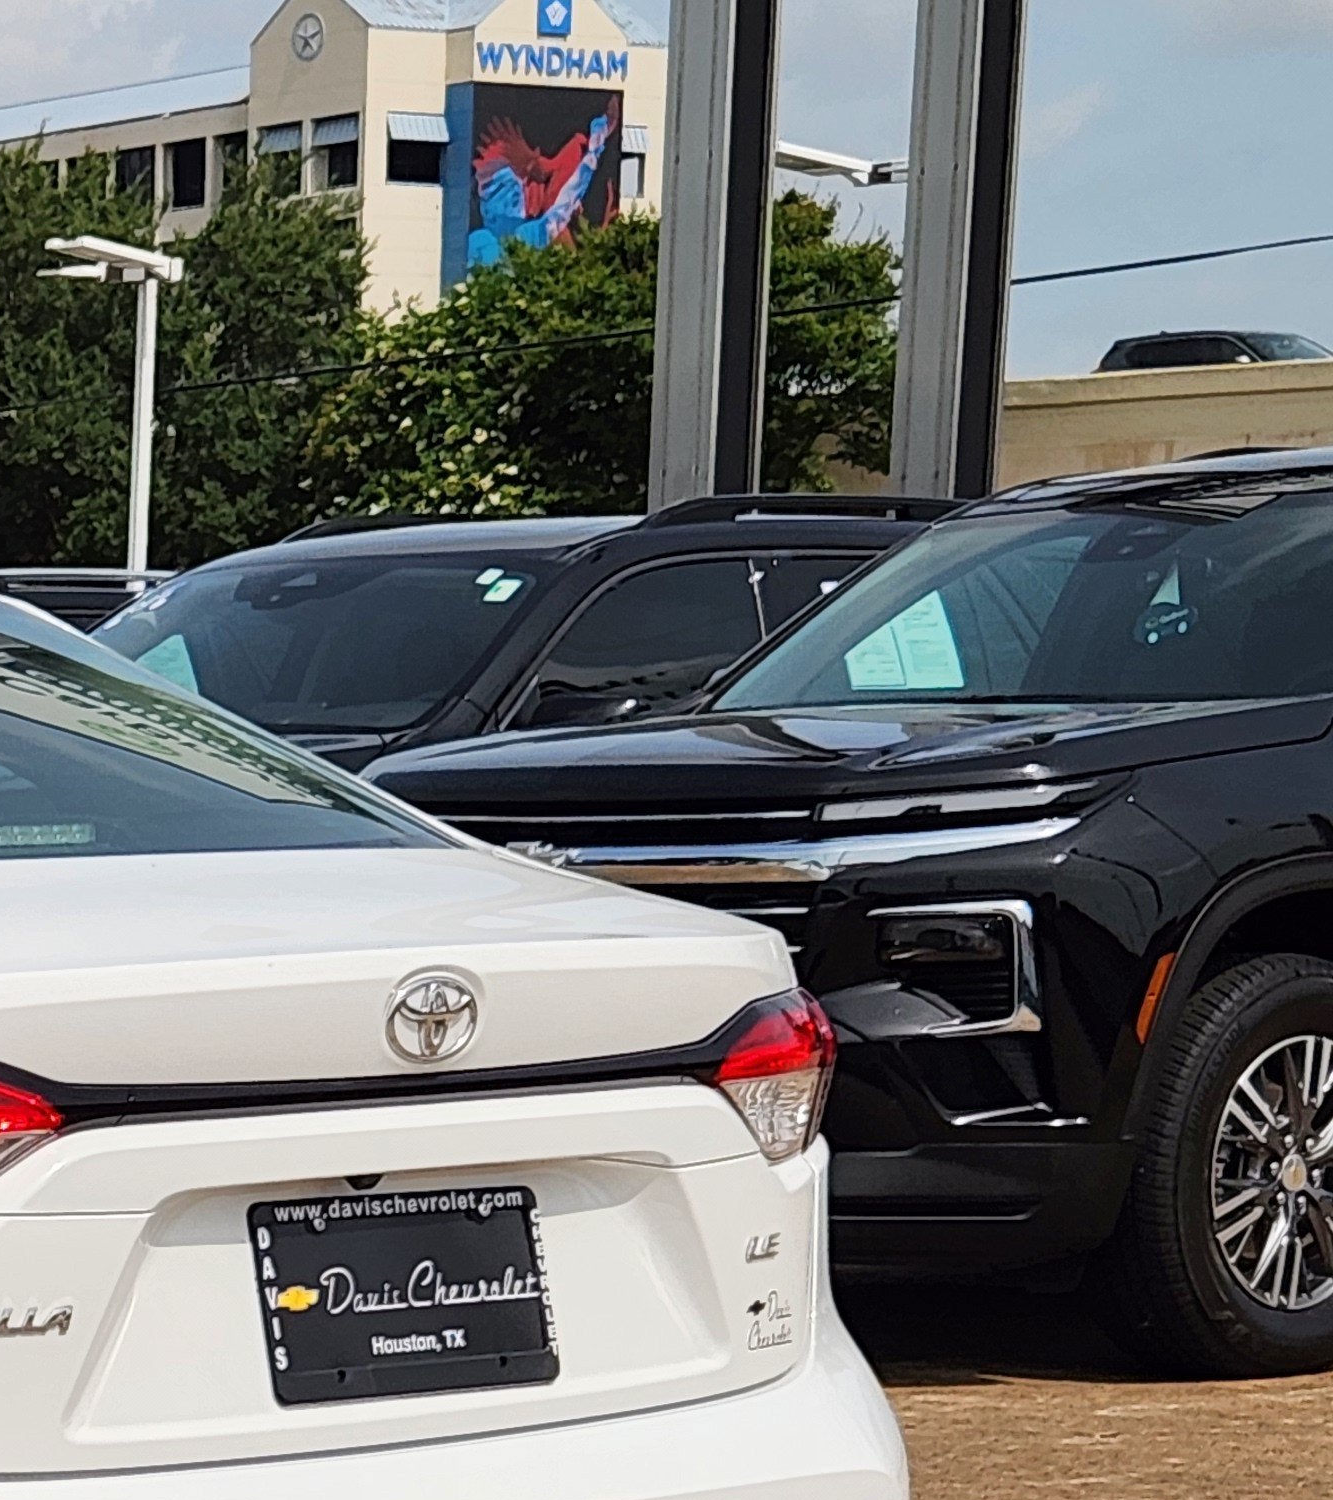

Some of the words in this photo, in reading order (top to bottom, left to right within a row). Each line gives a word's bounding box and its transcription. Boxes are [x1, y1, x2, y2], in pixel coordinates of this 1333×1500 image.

[477, 42, 628, 83] WYNDHAM
[745, 1232, 781, 1263] LE
[257, 1226, 289, 1371] DAVIS
[319, 1266, 410, 1315] Davis
[408, 1260, 541, 1308] Chevrolet
[371, 1333, 443, 1356] Houston,
[441, 1327, 467, 1349] TX
